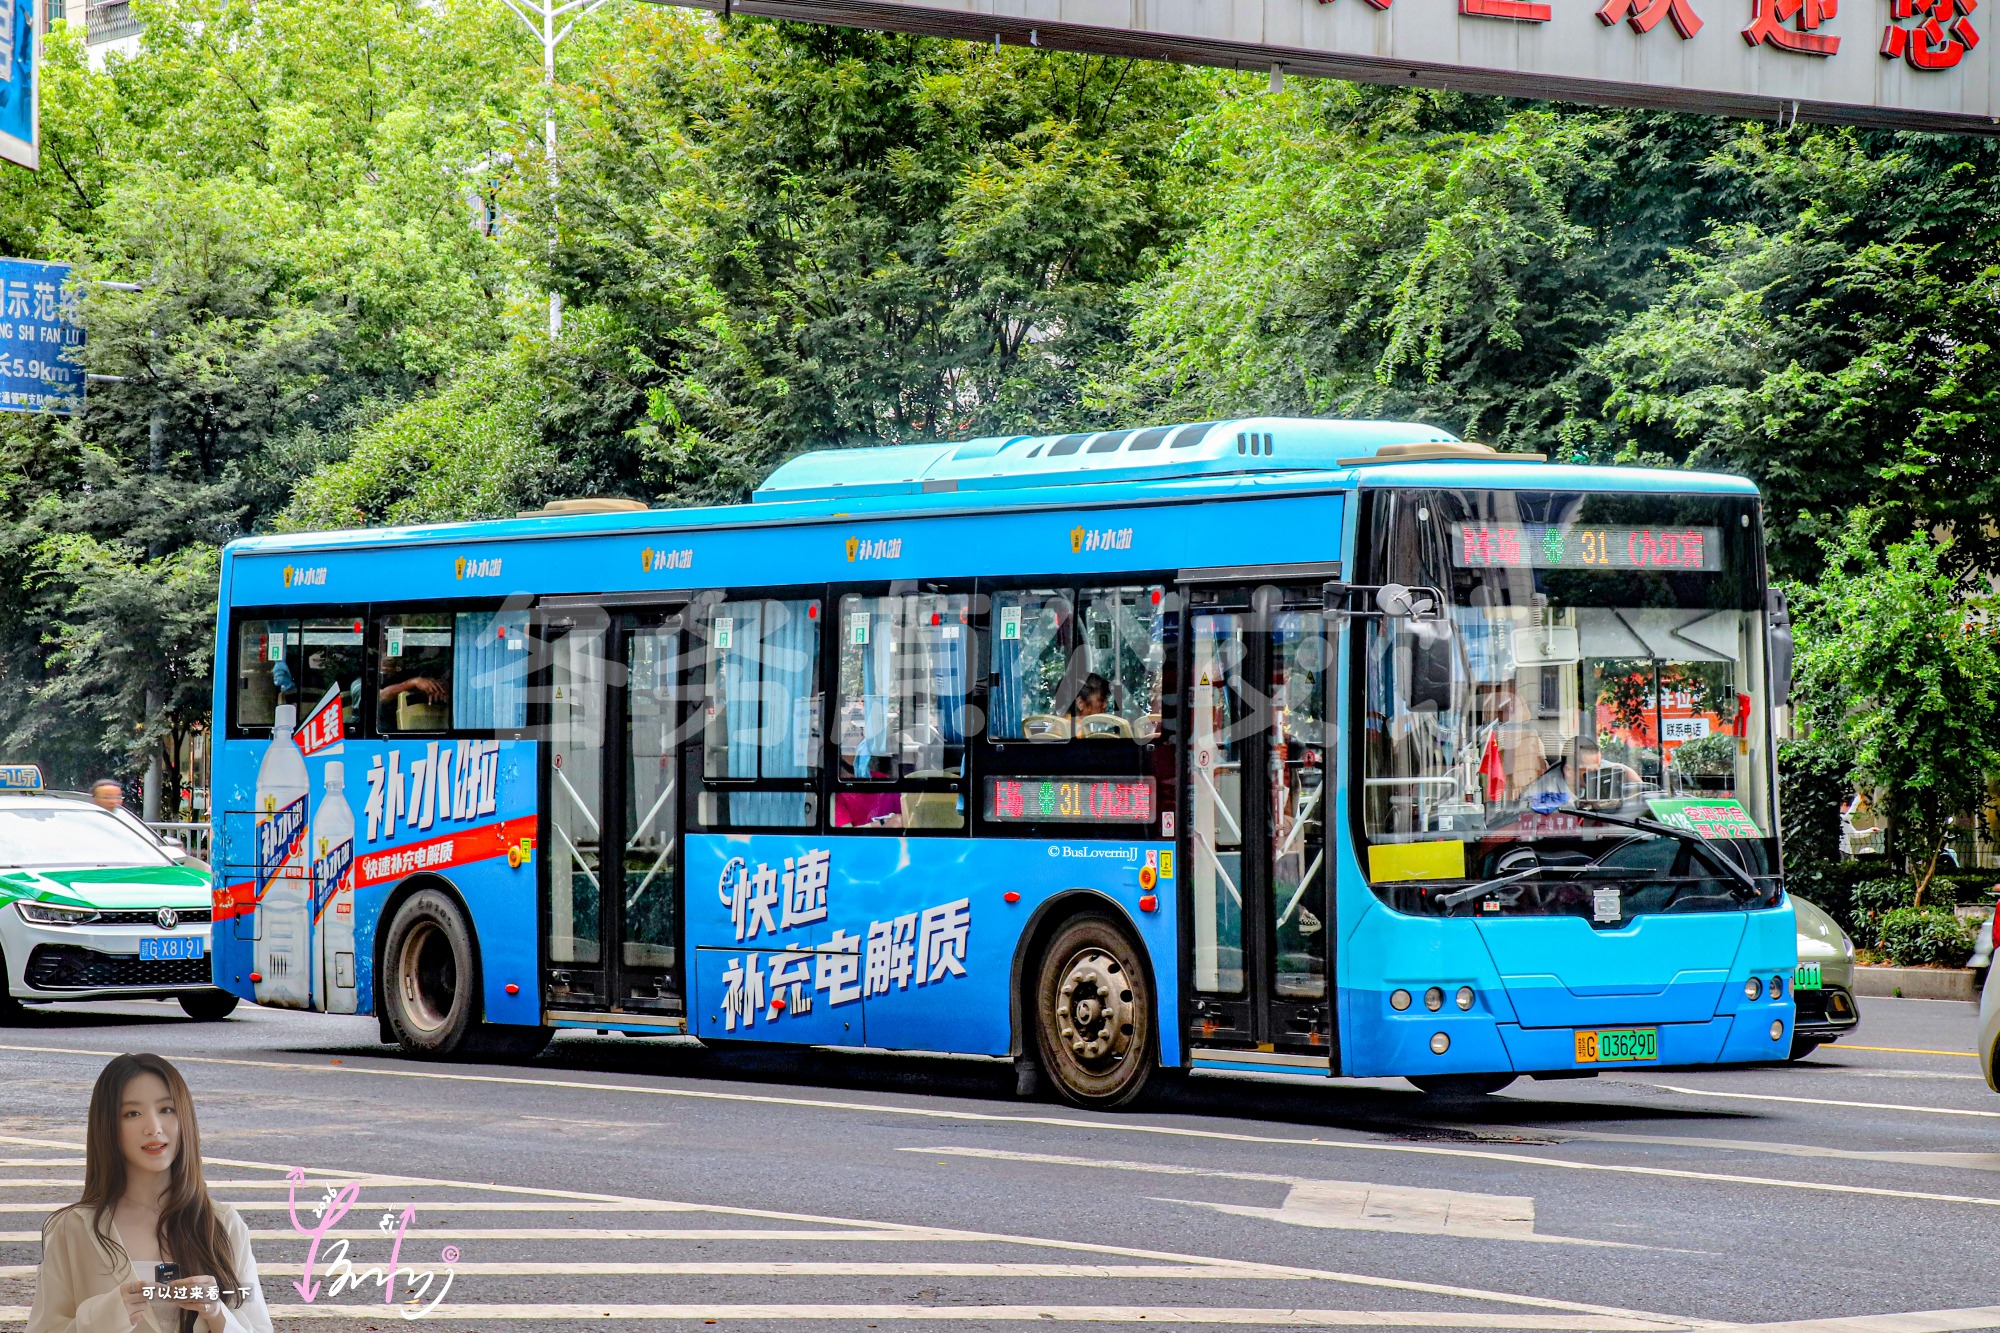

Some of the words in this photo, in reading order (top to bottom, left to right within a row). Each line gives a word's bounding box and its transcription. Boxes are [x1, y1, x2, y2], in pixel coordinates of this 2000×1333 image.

[18, 326, 34, 341] SHI
[40, 327, 61, 343] FAN
[66, 329, 79, 344] LU
[859, 537, 903, 560] 补水啦
[1085, 527, 1134, 551] 补水啦
[1581, 531, 1609, 563] 31
[466, 557, 503, 578] 补水啦
[654, 549, 694, 571] 补水啦
[293, 566, 328, 586] 补水啦
[303, 703, 340, 754] 1L装
[1666, 722, 1702, 738] 联系电话
[363, 739, 501, 842] 补水啦
[1060, 783, 1081, 815] 31
[1683, 806, 1748, 821] 空调开启
[1694, 823, 1760, 839] 票价2元
[365, 840, 454, 880] 快速补充电解质
[730, 848, 831, 940] 快速
[720, 897, 971, 1031] 补充电解质
